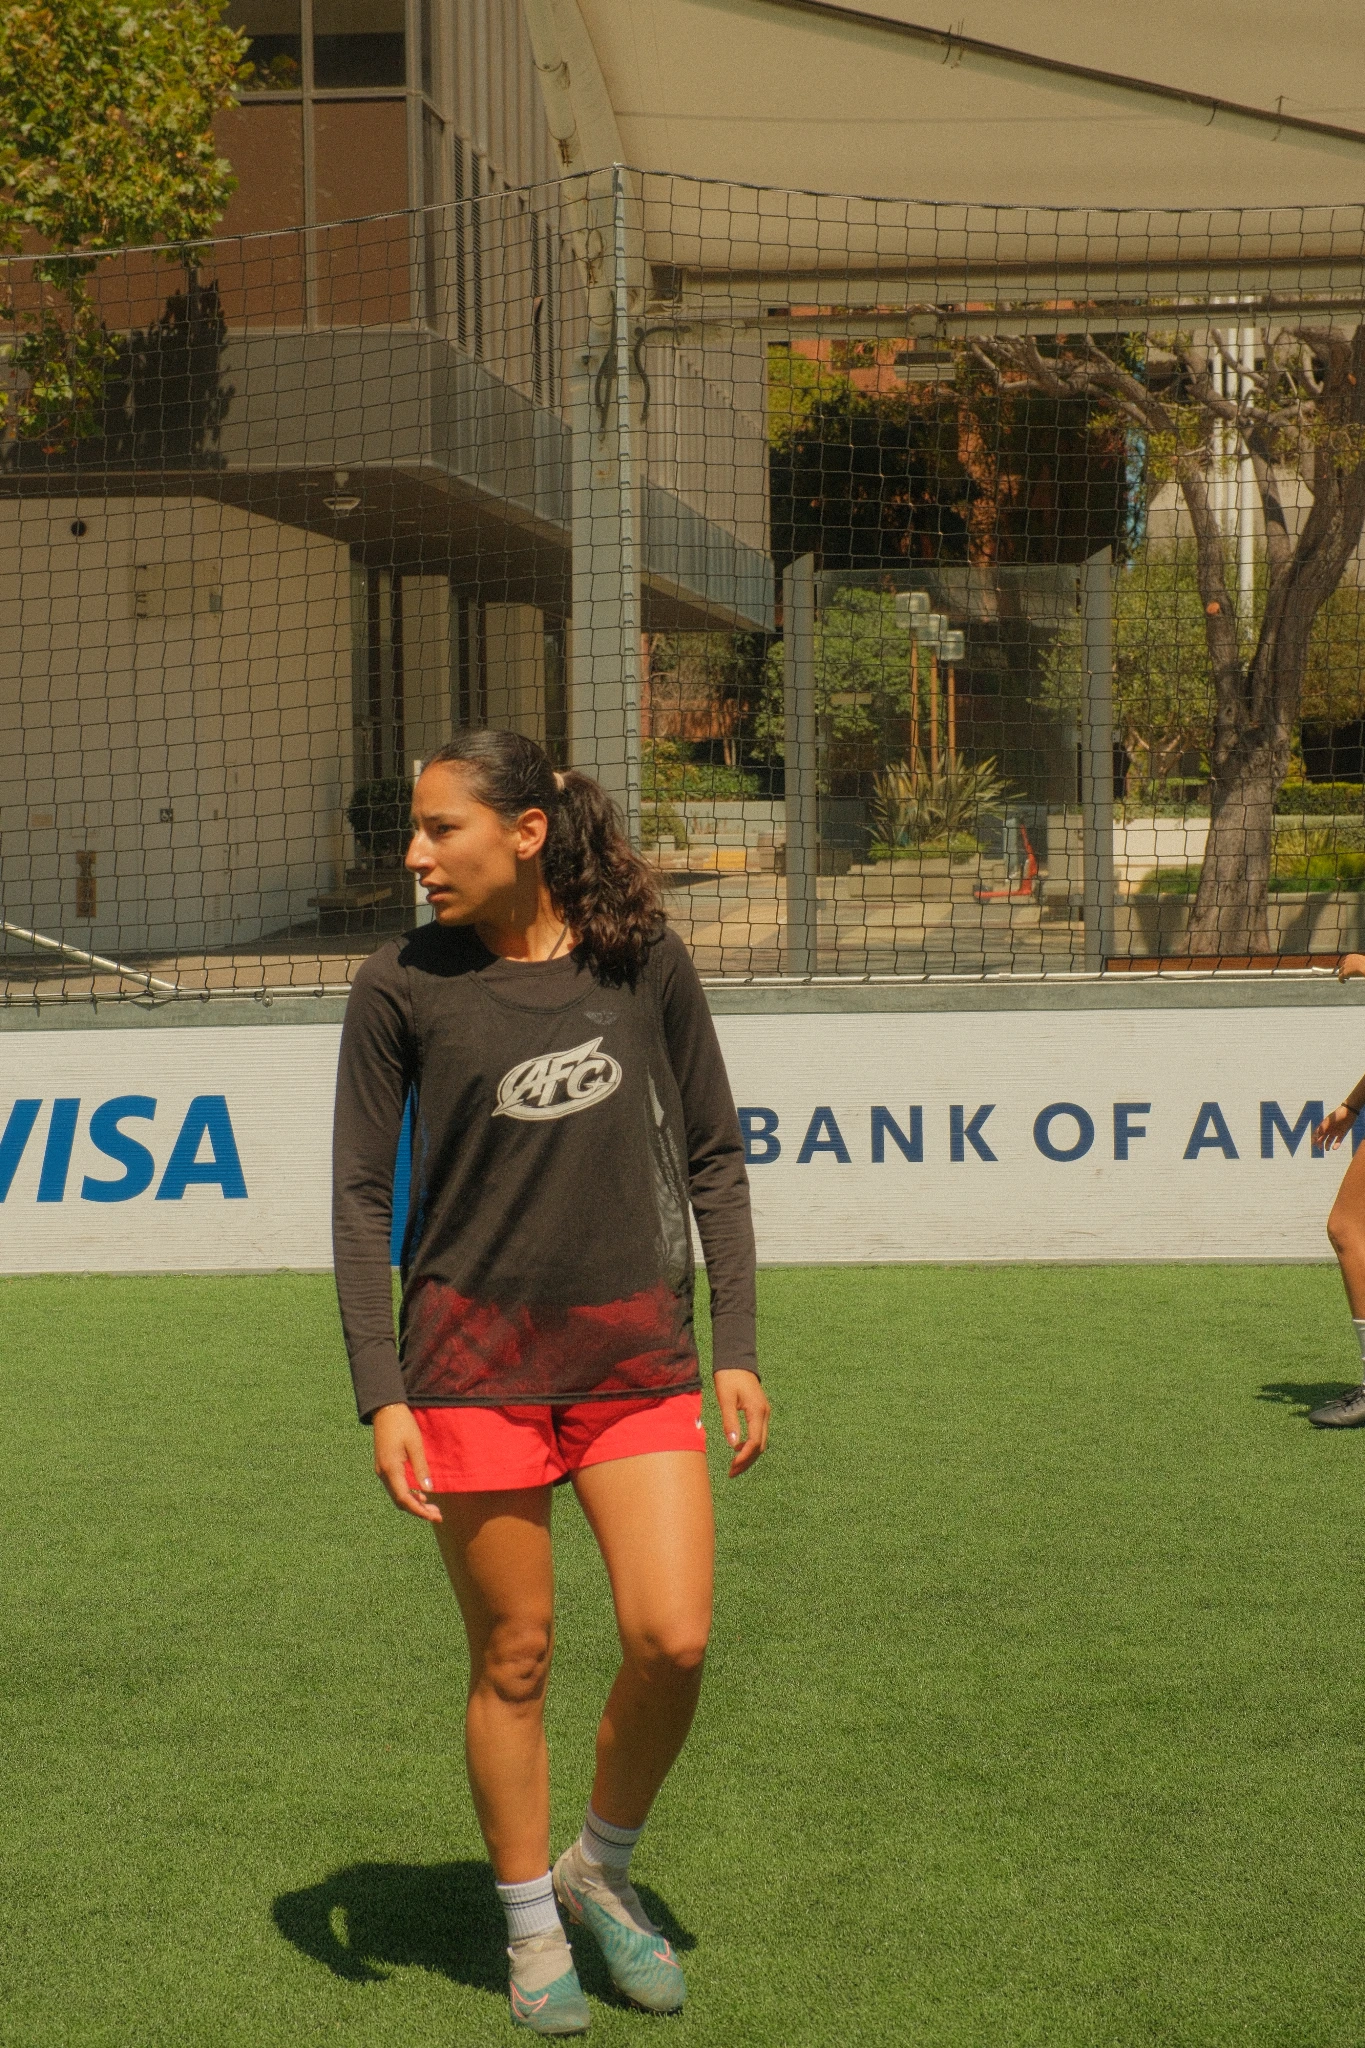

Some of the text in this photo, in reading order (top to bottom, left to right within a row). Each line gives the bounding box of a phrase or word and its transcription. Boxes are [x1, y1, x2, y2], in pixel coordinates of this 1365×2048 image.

[737, 1100, 1365, 1165] BANK OF AM
